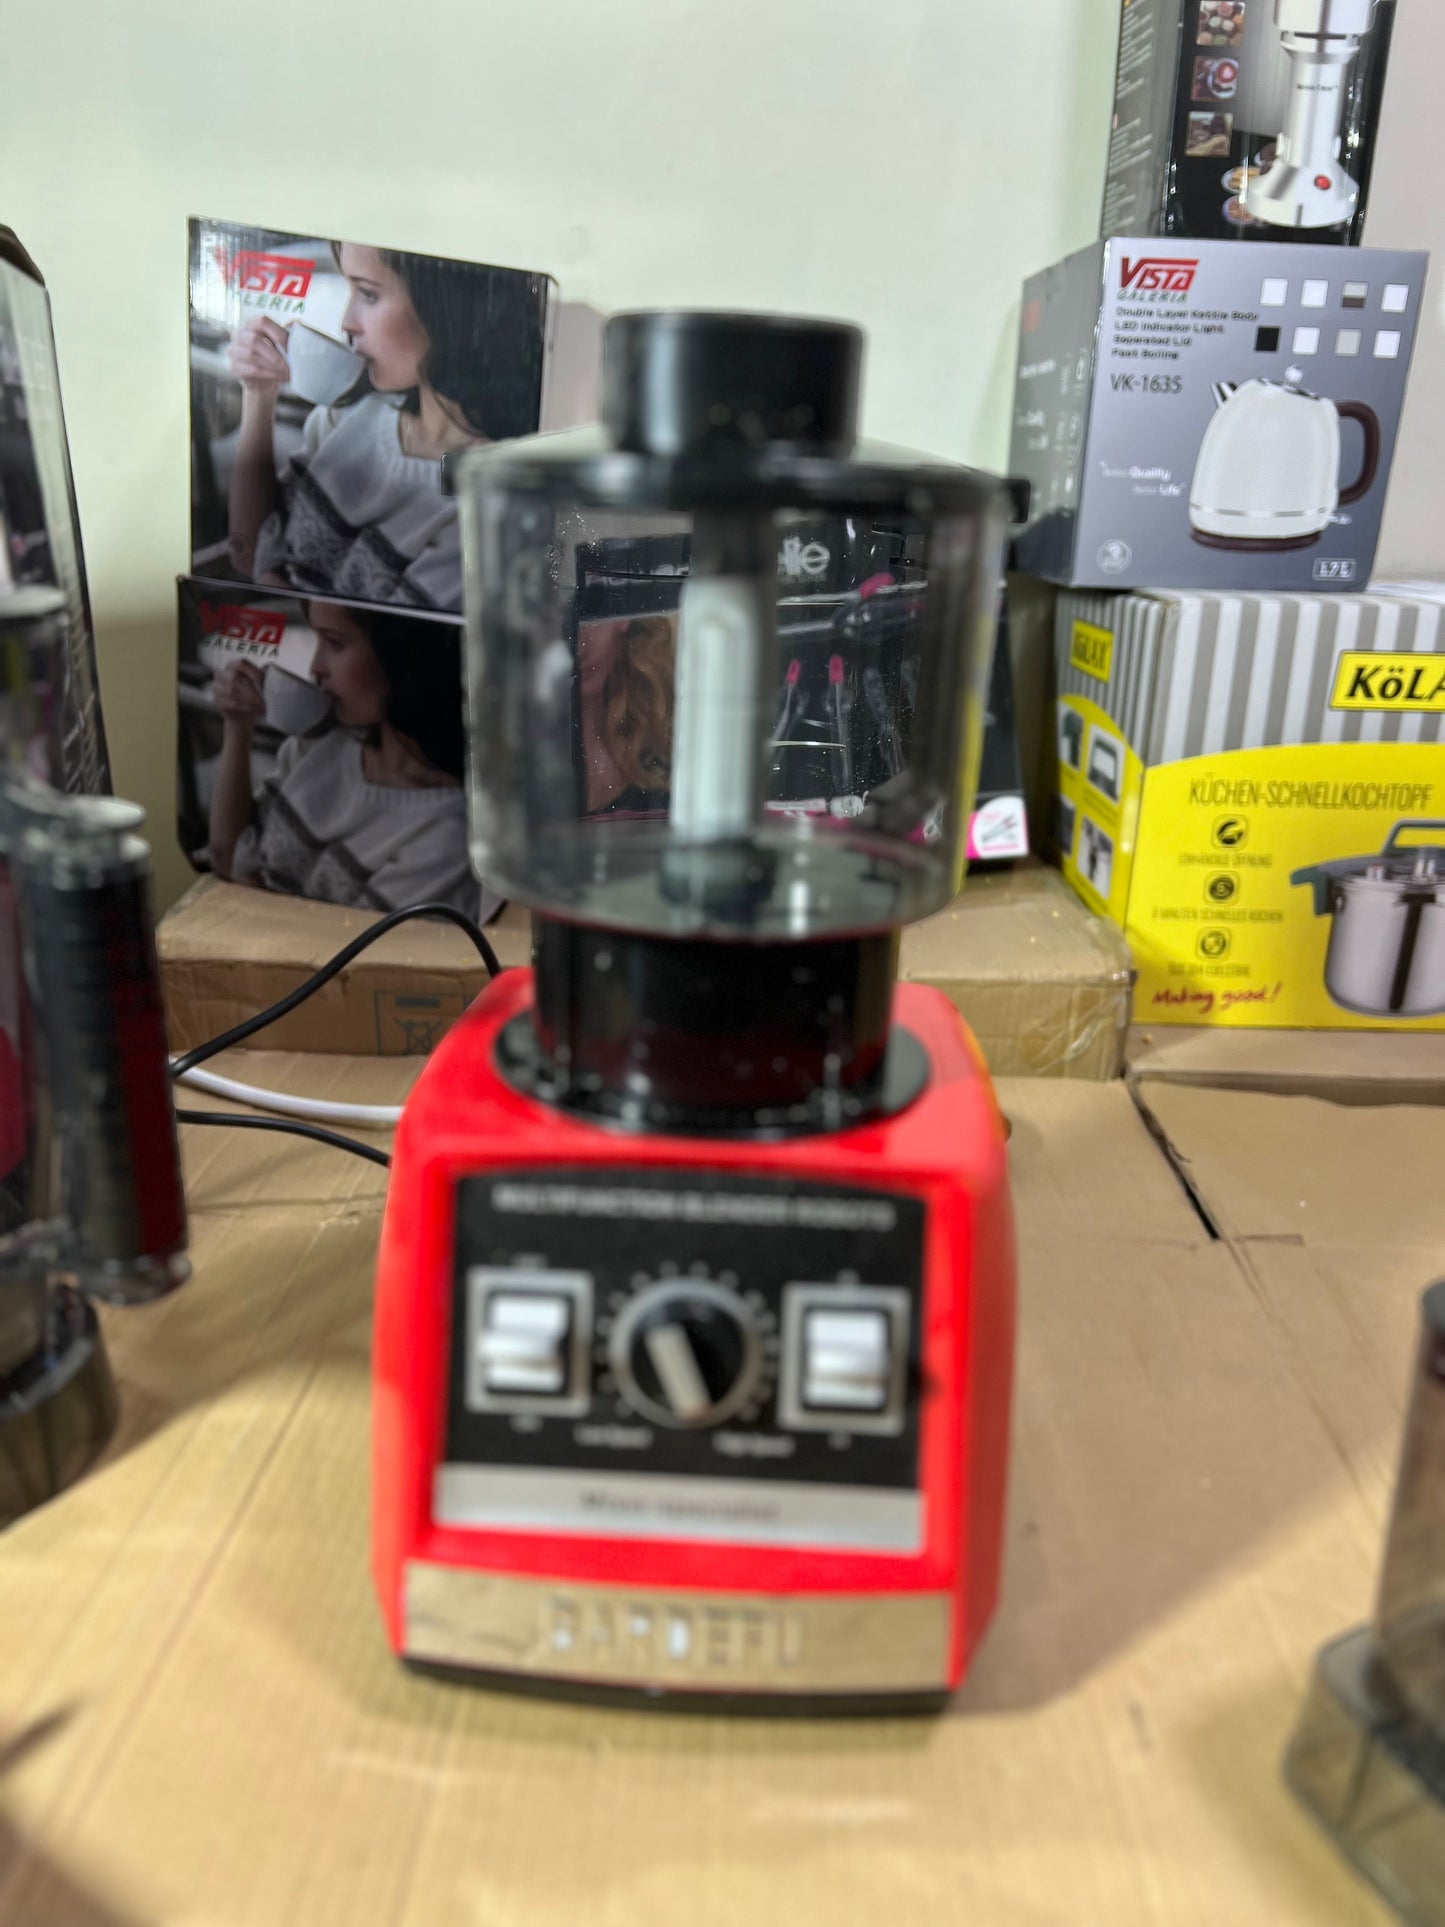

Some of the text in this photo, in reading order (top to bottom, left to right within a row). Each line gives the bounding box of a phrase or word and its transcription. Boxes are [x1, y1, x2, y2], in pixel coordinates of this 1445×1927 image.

[214, 247, 316, 298] VISTA
[1120, 257, 1199, 291] VISTA
[1117, 290, 1187, 303] GALERIA
[1116, 307, 1154, 318] Double
[1157, 308, 1187, 320] Layer
[1231, 310, 1258, 322] Body
[1115, 320, 1225, 335] LED Indicator Light
[1173, 335, 1192, 347] Lid
[1141, 348, 1179, 360] Boiling
[1111, 373, 1183, 394] VK-1635
[199, 599, 289, 645] VISTA
[1152, 985, 1215, 1014] Making
